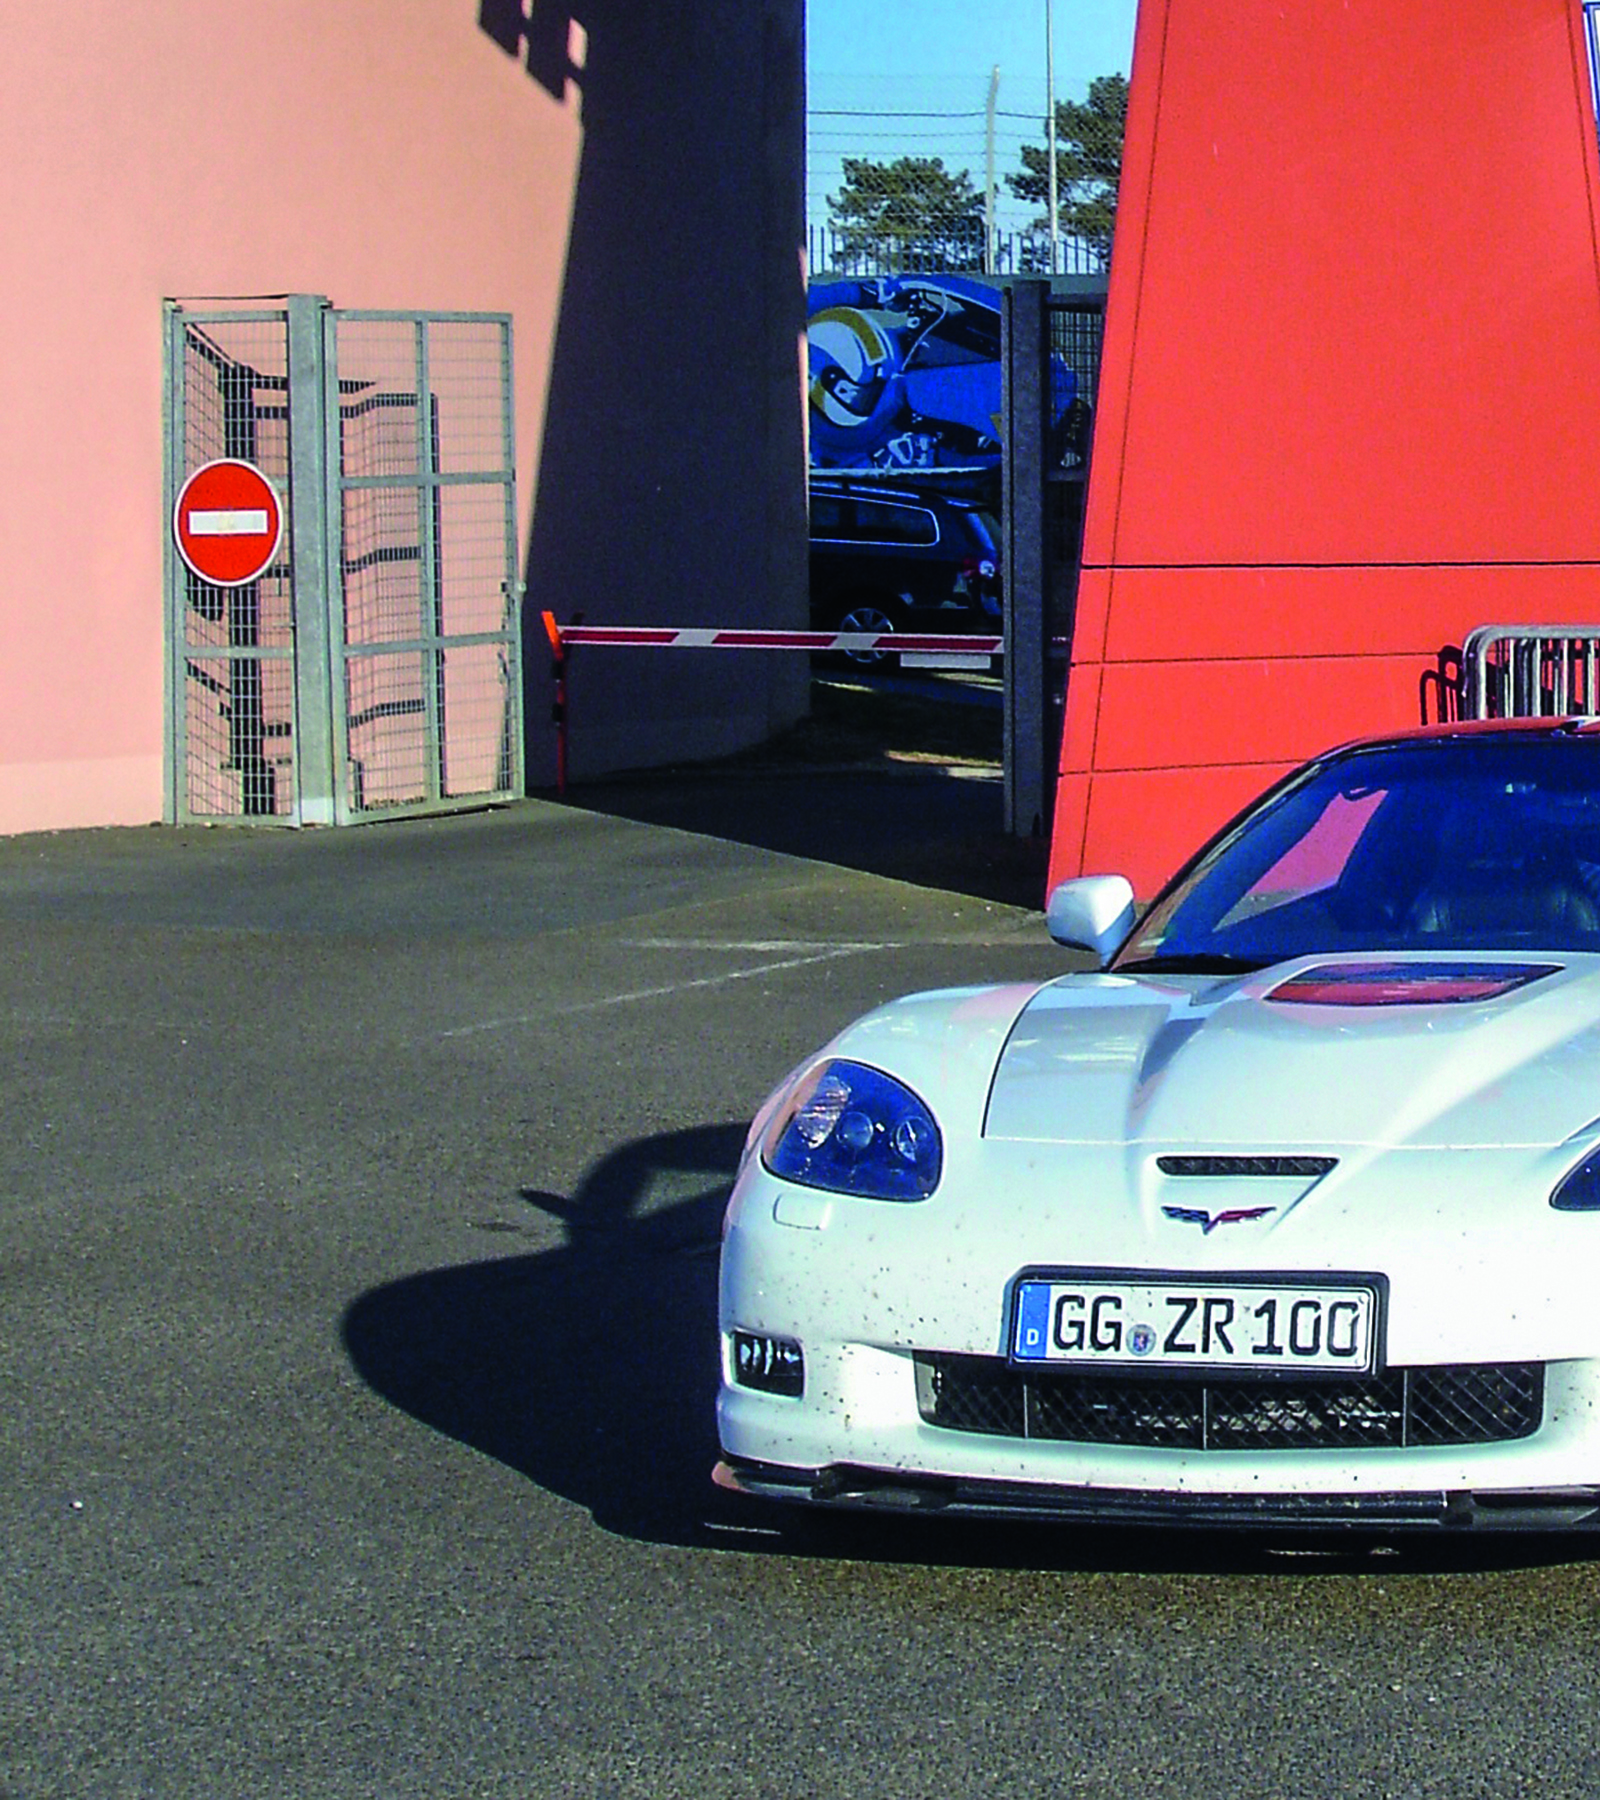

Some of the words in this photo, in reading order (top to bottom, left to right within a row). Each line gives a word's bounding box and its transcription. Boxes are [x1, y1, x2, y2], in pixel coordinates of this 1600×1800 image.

[1026, 1329, 1039, 1346] D
[1052, 1295, 1123, 1352] GG
[1163, 1297, 1235, 1355] ZR
[1251, 1298, 1360, 1357] 100
